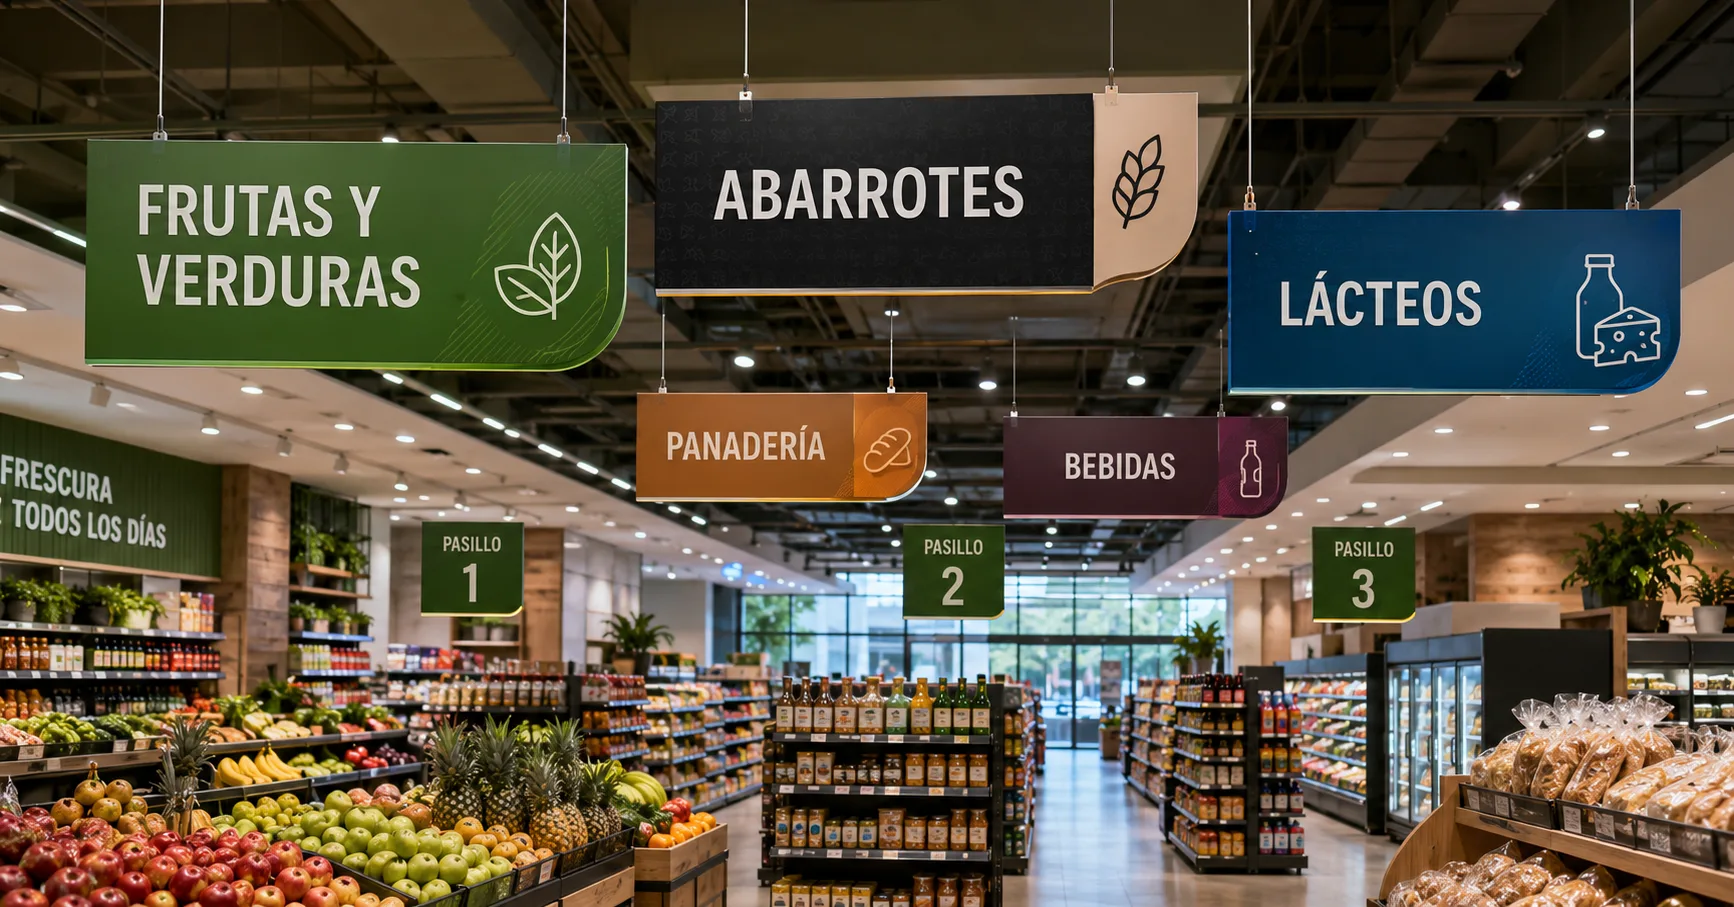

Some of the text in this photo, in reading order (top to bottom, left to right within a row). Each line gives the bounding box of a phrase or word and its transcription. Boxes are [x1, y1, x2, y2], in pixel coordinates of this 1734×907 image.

[138, 184, 381, 238] FRUTAS Y
[713, 165, 1024, 220] ABARROTES
[136, 253, 421, 308] VERDURAS
[1280, 270, 1482, 327] LÁCTEOS
[666, 424, 826, 462] PANADERÍA
[0, 454, 113, 505] FRESCURA
[1064, 452, 1176, 481] BEBIDAS
[11, 498, 81, 537] TODOS
[87, 511, 122, 543] LOS
[127, 514, 167, 549] DÍAS
[443, 536, 502, 552] PASILLO
[924, 538, 983, 555] PASILLO
[1335, 541, 1394, 558] PASILLO
[462, 563, 477, 603] 1
[941, 566, 964, 606] 2
[1352, 568, 1375, 609] 3
